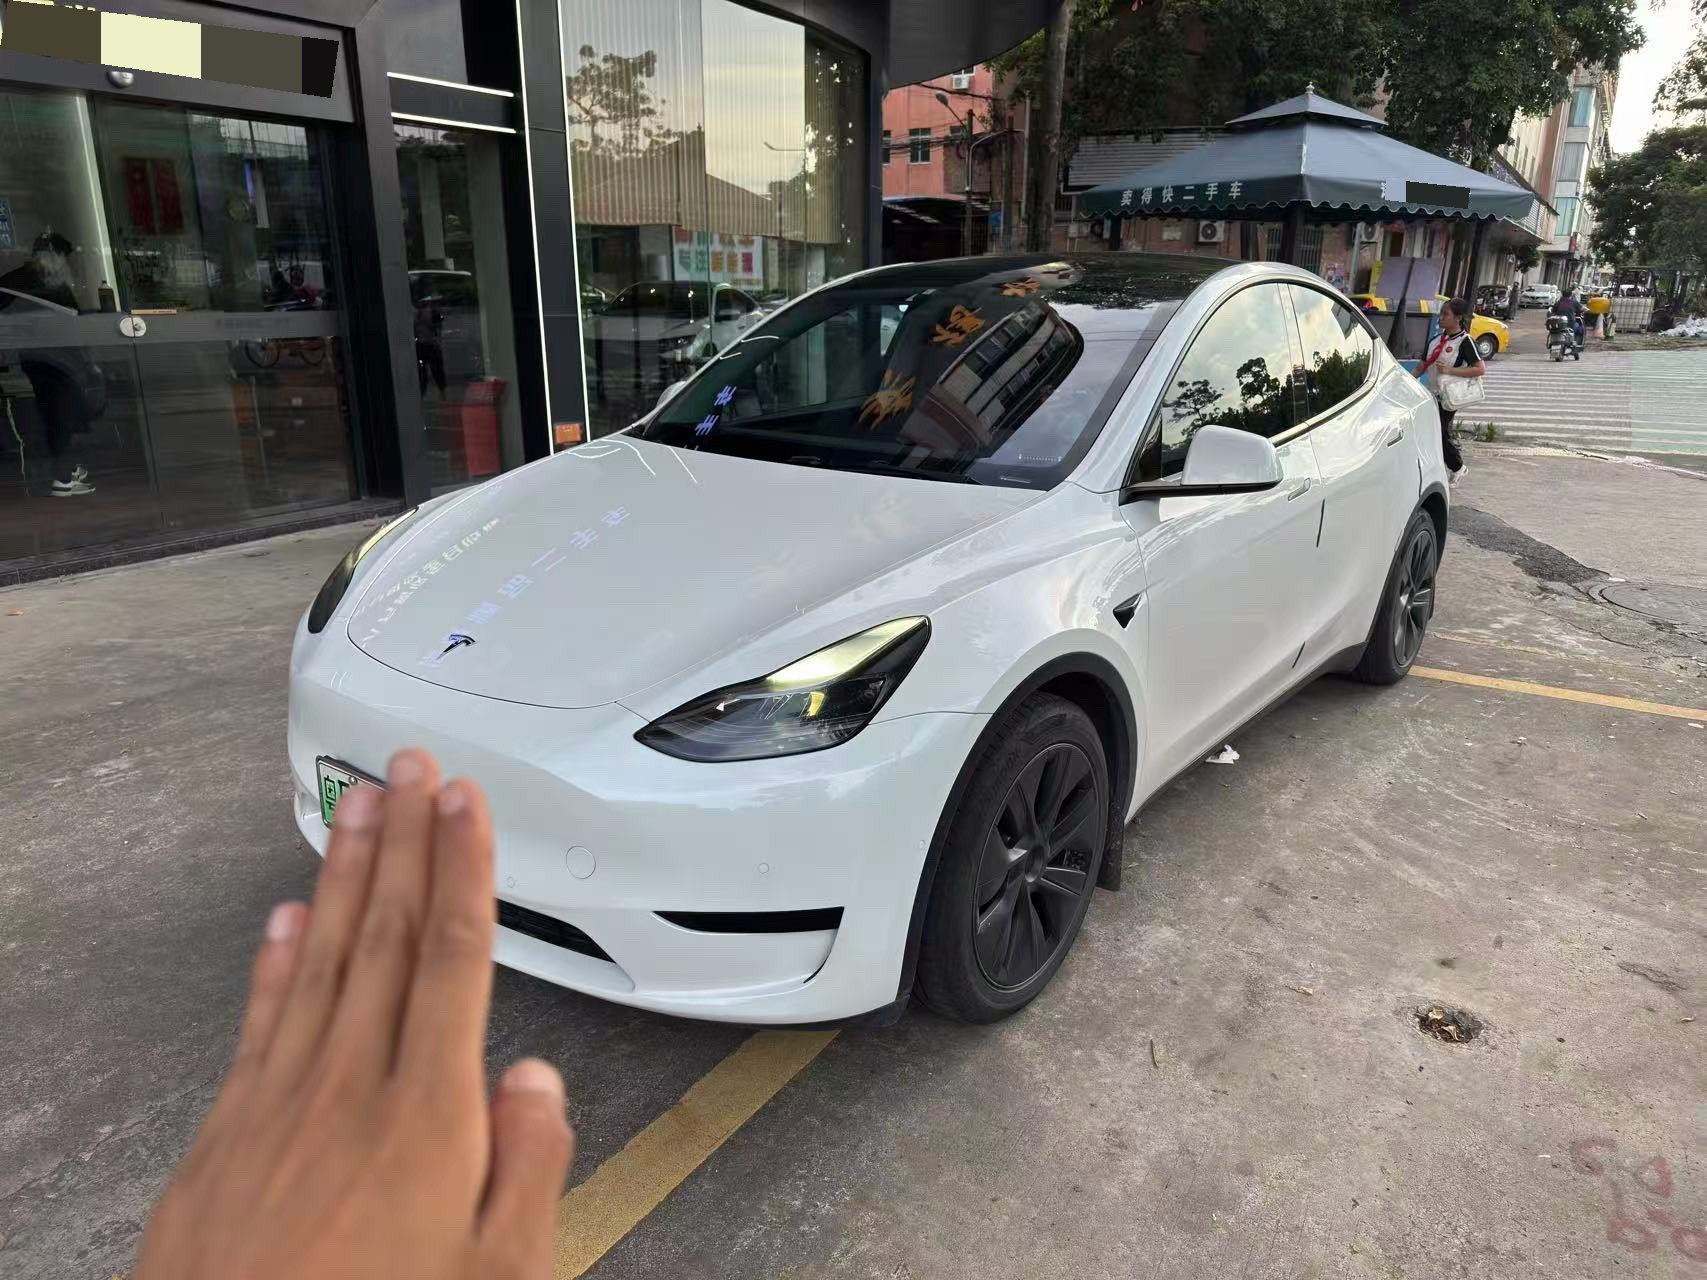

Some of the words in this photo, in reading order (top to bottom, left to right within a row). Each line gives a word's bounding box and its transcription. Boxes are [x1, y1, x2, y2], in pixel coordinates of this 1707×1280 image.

[1120, 181, 1242, 207] 卖得快二手车
